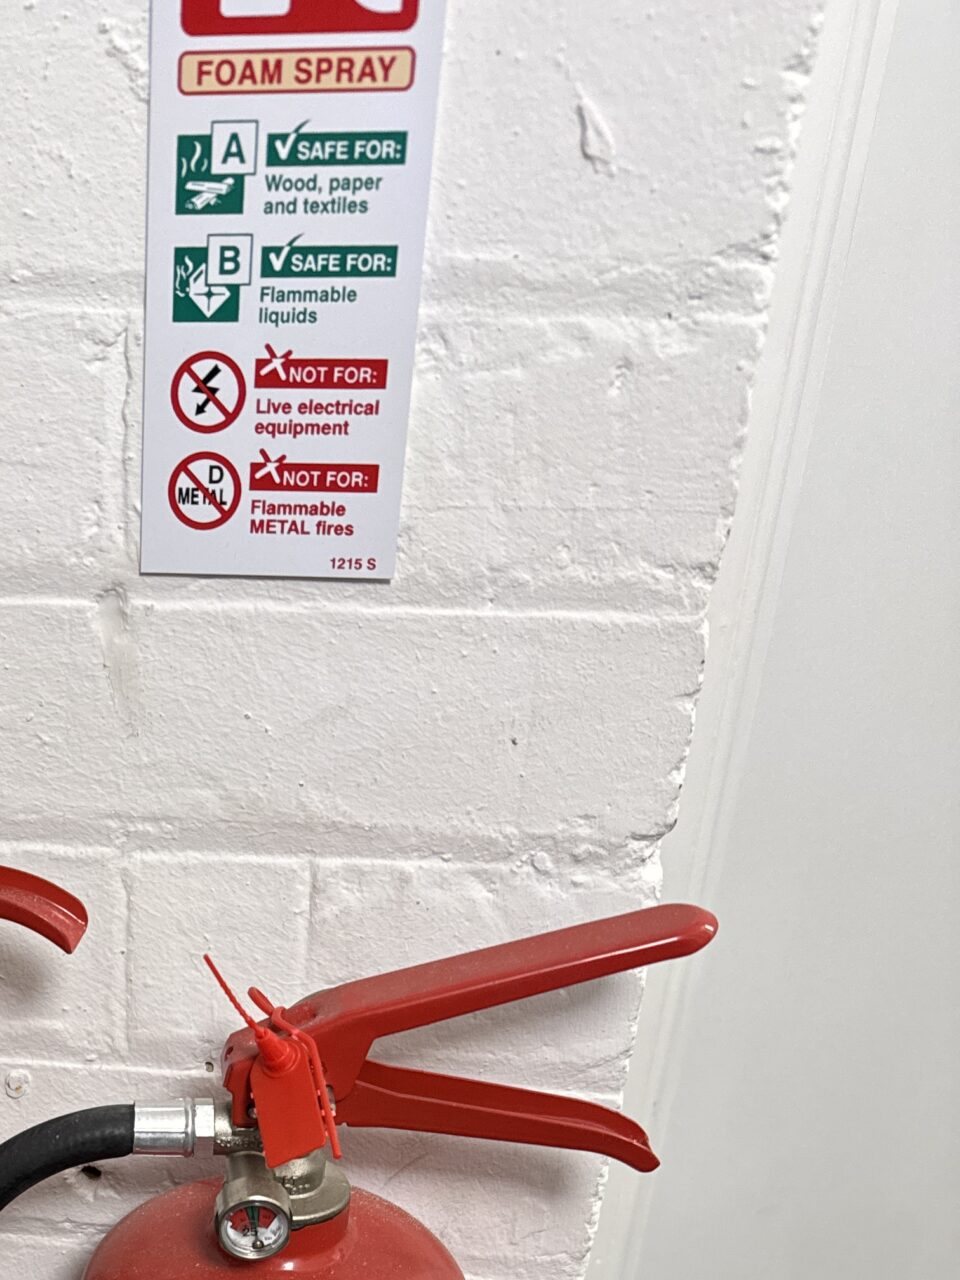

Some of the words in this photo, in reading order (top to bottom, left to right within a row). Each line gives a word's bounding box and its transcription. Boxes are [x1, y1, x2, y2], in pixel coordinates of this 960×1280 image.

[196, 59, 283, 87] FOAM
[293, 56, 397, 85] SPRAY
[221, 132, 246, 165] A
[296, 141, 349, 161] SAFE
[353, 139, 402, 160] FOR:
[265, 174, 323, 195] Wood,
[328, 175, 383, 195] paper
[263, 198, 297, 215] and
[303, 197, 368, 215] textiles
[218, 245, 241, 276] B
[290, 254, 342, 273] SAFE
[346, 253, 392, 272] FOR:
[259, 286, 357, 303] Flammable
[258, 307, 318, 328] liquids
[289, 366, 328, 383] NOT
[332, 366, 378, 384] FOR:
[255, 398, 293, 415] Live
[297, 399, 380, 416] electrical
[254, 420, 350, 439] equipment
[208, 464, 225, 485] D
[281, 470, 321, 487] NOT
[325, 470, 369, 488] FOR:
[250, 499, 347, 517] Flammable
[249, 519, 310, 536] METAL
[315, 519, 355, 536] fires
[329, 557, 364, 571] 1215
[366, 557, 377, 571] S
